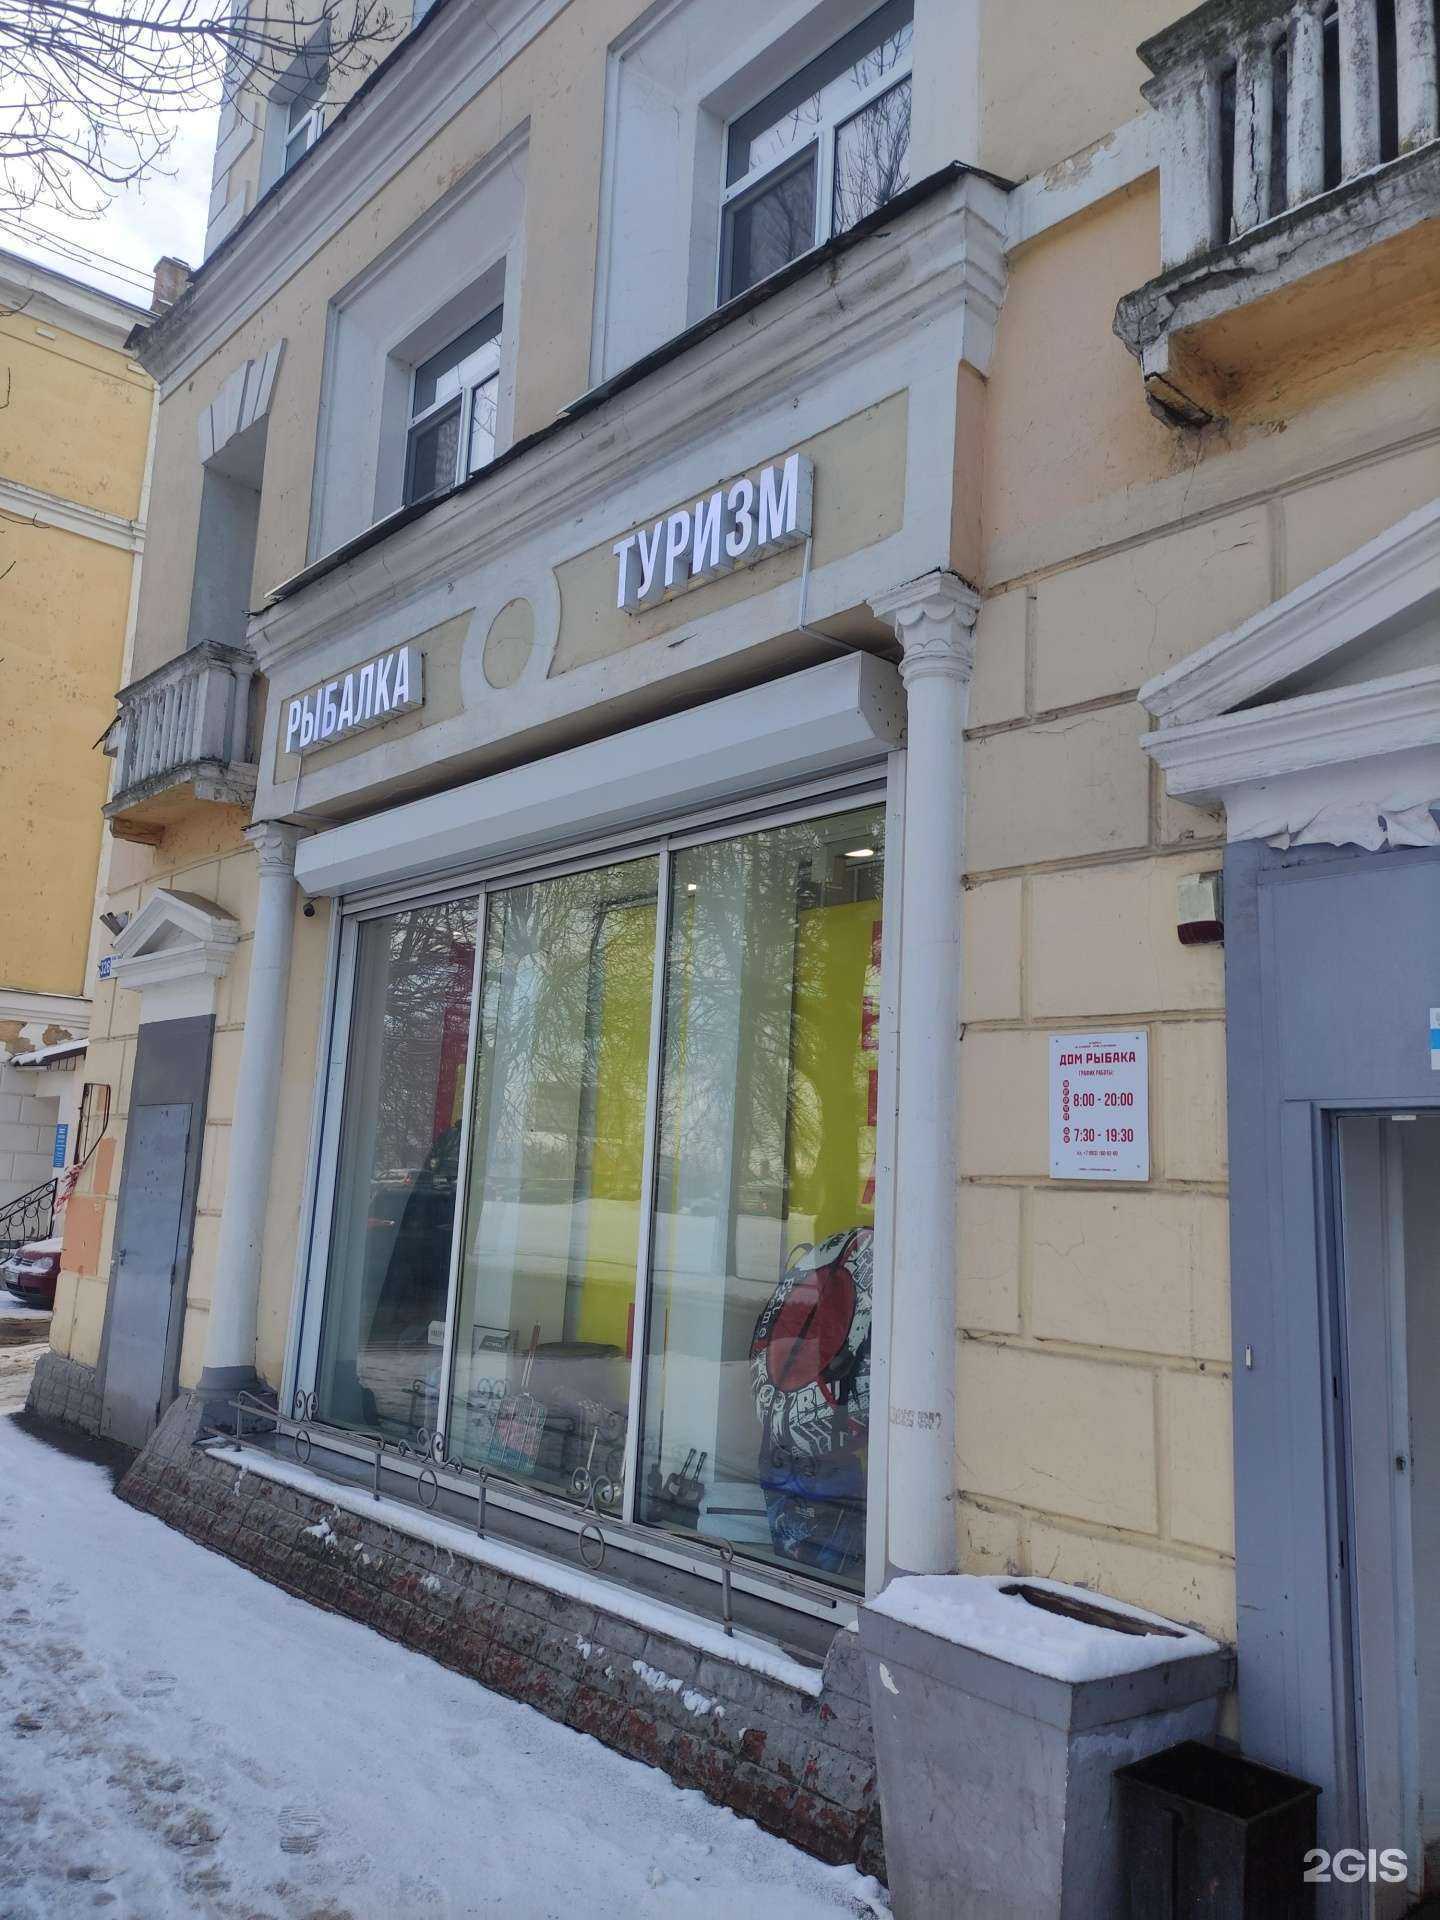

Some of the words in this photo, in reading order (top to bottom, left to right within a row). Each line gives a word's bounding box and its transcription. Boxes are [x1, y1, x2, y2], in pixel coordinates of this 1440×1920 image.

[612, 453, 802, 609] ТУРИЗМ
[284, 646, 410, 754] РЫБАЛКА
[1059, 1053, 1083, 1066] ДОМ
[1086, 1051, 1136, 1065] РЫБАКА
[1073, 1093, 1095, 1107] 8:00
[1104, 1092, 1134, 1106] 20:00
[1074, 1128, 1095, 1142] 7:30
[1106, 1128, 1134, 1142] 19:30
